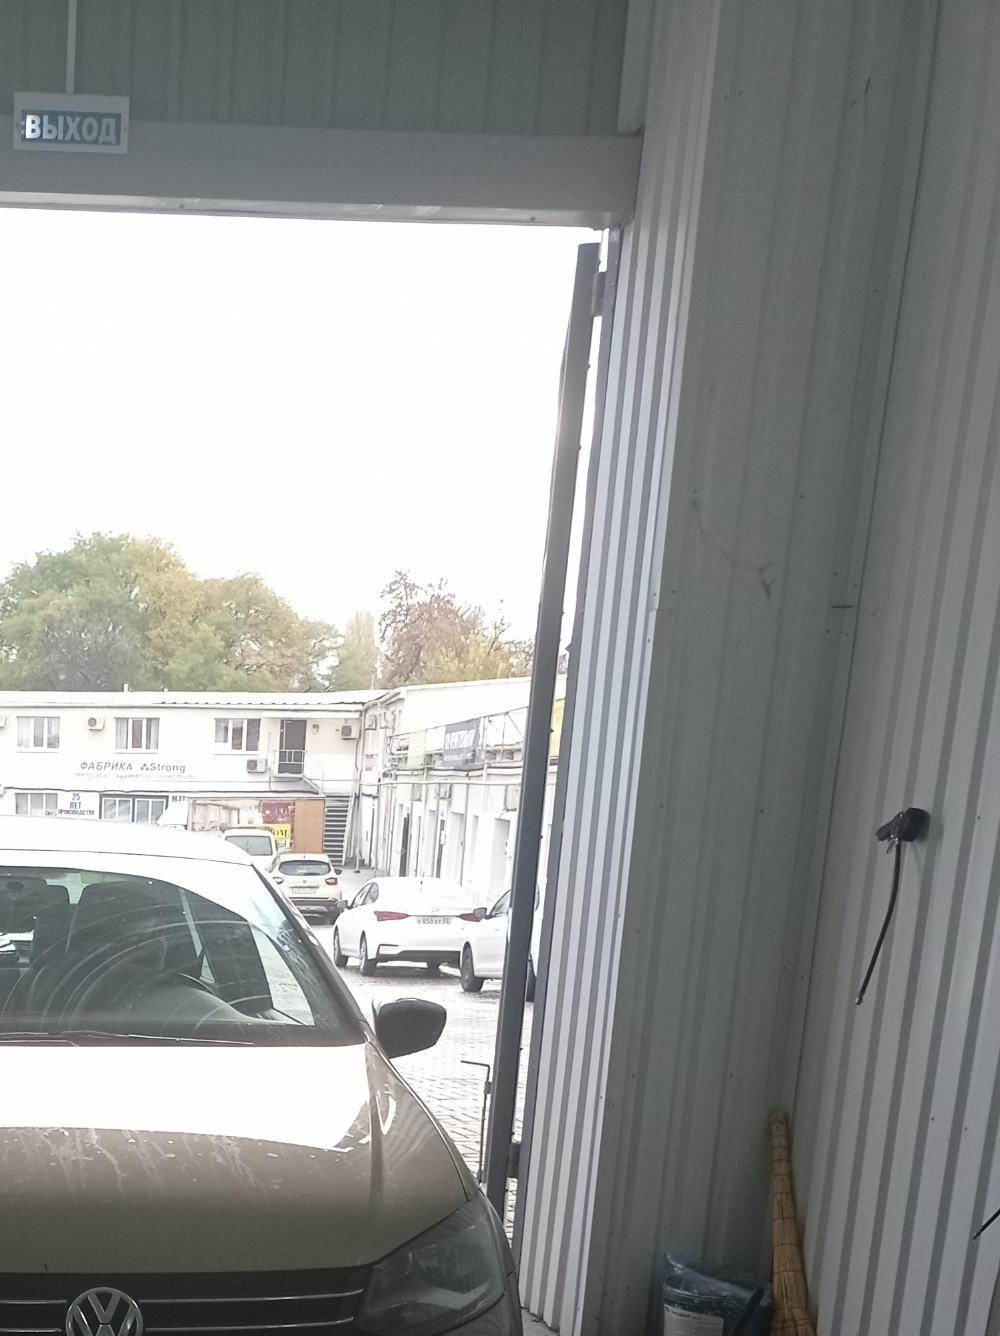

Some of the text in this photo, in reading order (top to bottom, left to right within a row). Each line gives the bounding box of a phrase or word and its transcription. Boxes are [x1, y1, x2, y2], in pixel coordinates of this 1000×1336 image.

[25, 114, 117, 144] ВЫХОД
[80, 761, 133, 771] ФАБРИКА
[72, 793, 81, 801] 25
[69, 801, 82, 810] ЛЕТ
